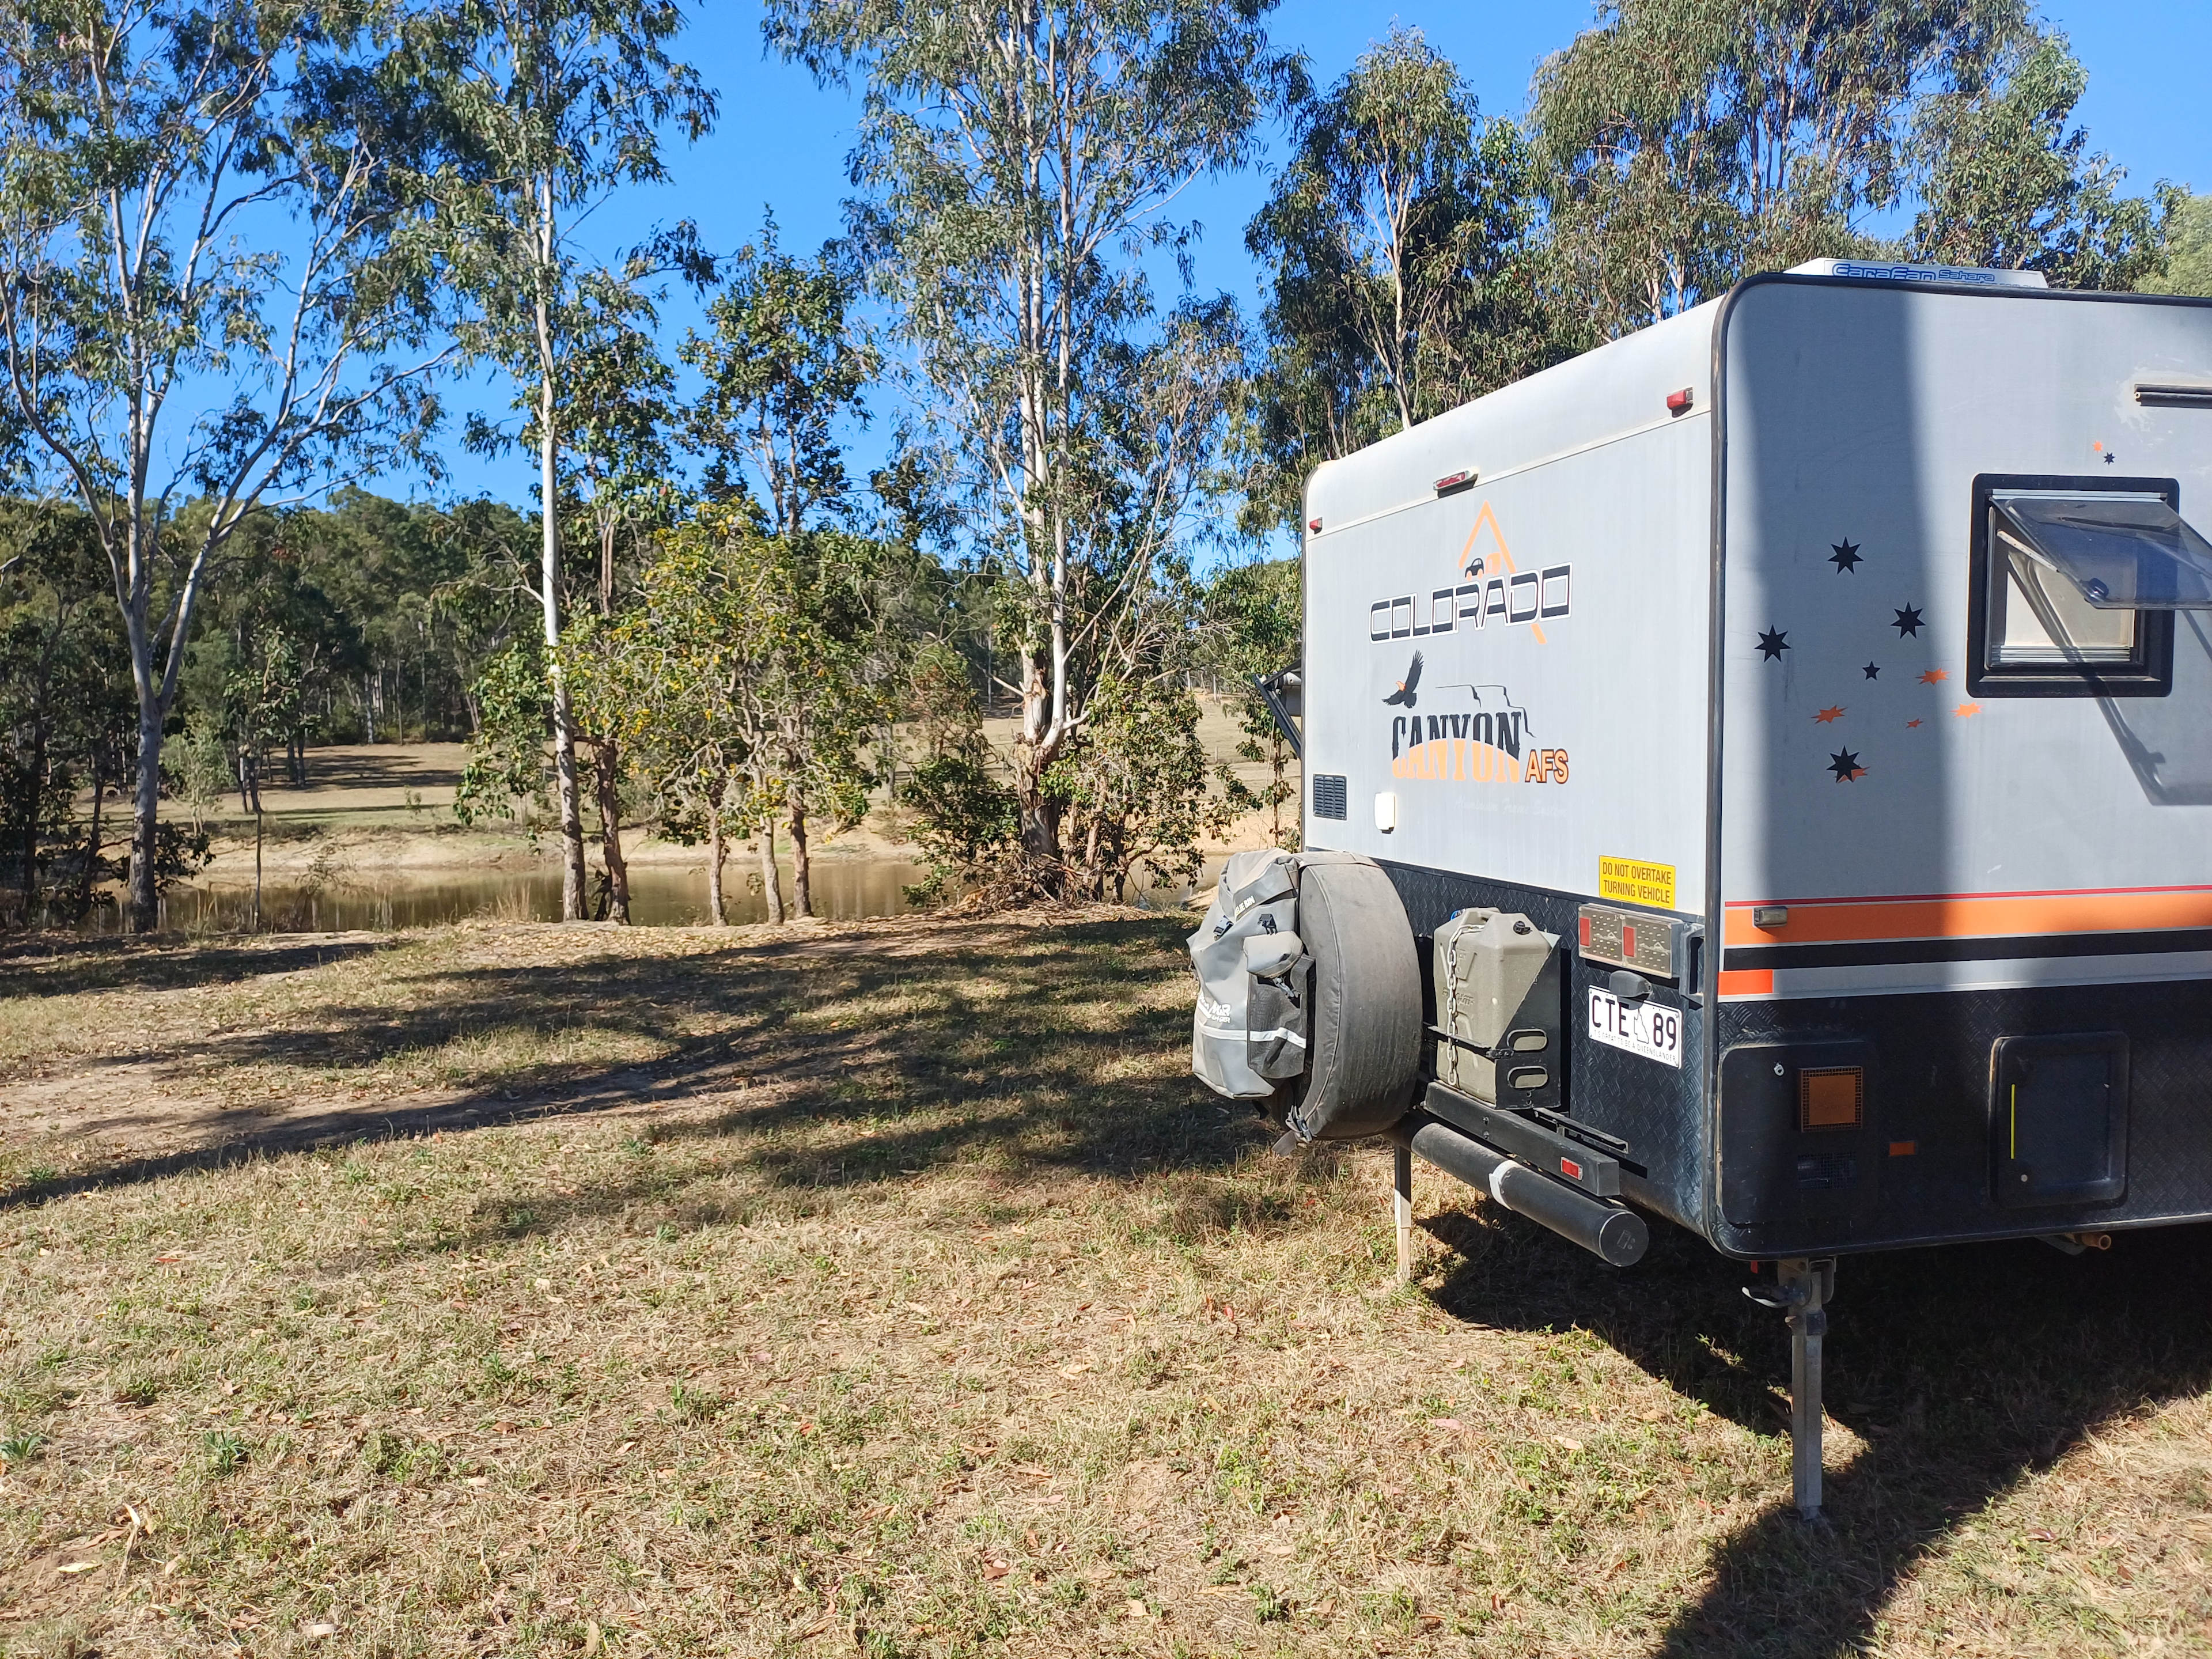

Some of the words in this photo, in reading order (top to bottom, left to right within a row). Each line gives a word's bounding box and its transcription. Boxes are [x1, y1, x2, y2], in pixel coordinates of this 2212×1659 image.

[1938, 270, 1995, 281] Sahara
[1369, 562, 1572, 643] COLORADO
[1392, 712, 1521, 783] CANYON
[1525, 748, 1569, 784] AFS
[1603, 862, 1612, 875] DO
[1615, 863, 1629, 877] NOT
[1631, 866, 1672, 885] OVERTAKE
[1603, 880, 1635, 897] TURNING
[1638, 885, 1670, 903] VEHICLE
[1592, 995, 1629, 1037] CTE
[1653, 1013, 1676, 1051] 89
[1602, 1031, 1616, 1041] GREAT
[1618, 1037, 1624, 1046] TO
[1625, 1040, 1631, 1048] BE
[1637, 1043, 1676, 1061] QUEENSLANDER
